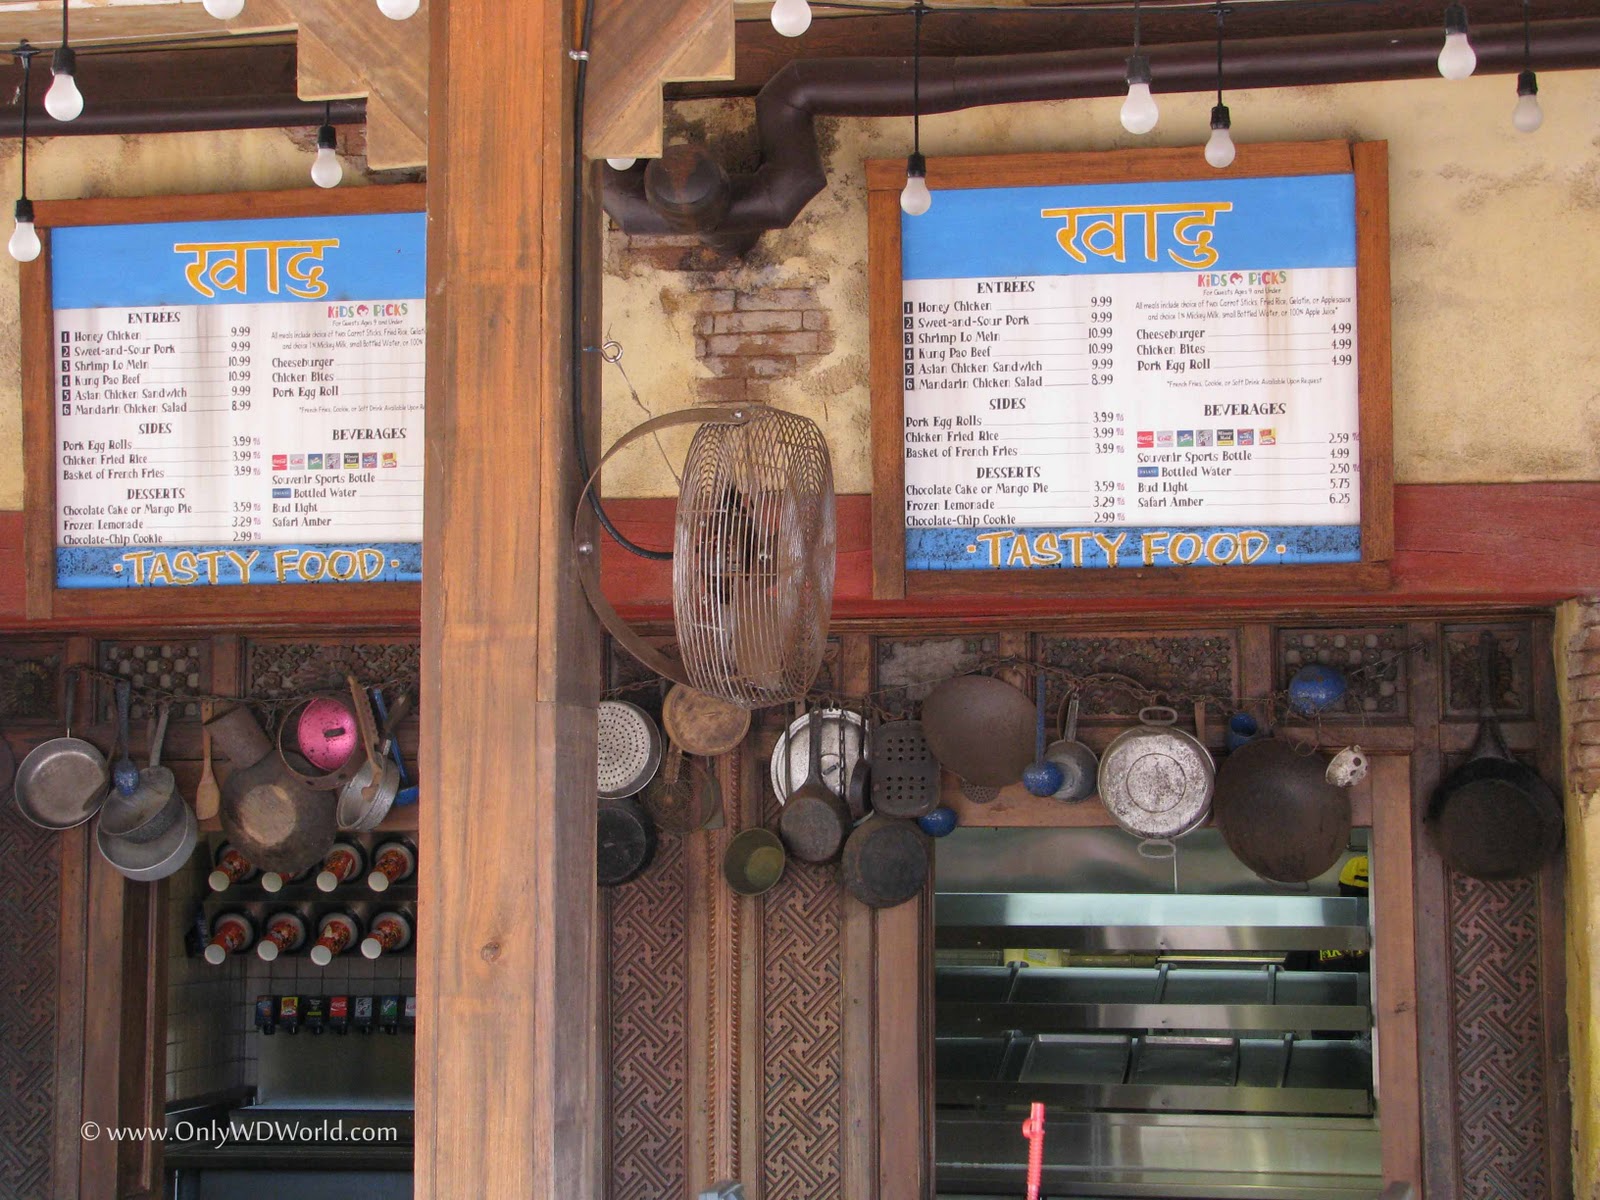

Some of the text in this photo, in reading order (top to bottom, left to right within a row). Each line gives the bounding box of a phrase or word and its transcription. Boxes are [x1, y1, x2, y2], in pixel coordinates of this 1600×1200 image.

[1235, 288, 1247, 296] Ages
[918, 296, 1112, 314] Honey Chicken 9.99
[918, 312, 1112, 328] Sweet-and-Sour Pork 9.99
[74, 327, 250, 343] Honey Chicken 9.99
[918, 327, 1112, 344] Shrimp Lo Mein 10.99
[1137, 323, 1351, 341] Cheeseburger 4.99
[75, 341, 250, 356] Sweet-and-Sour Pork 9.99
[919, 343, 1113, 361] Kung Pao Beef 10.99
[1137, 339, 1351, 356] Chicken Bites 4.99
[75, 356, 250, 372] Shrimp Lo Mein 10.99
[272, 358, 334, 370] Cheeseburger
[918, 358, 1113, 374] Asian Chicken Sandwich 9.99
[1137, 355, 1351, 373] Pork Egg Roll 4.99
[75, 371, 250, 387] Kung Pao Beef 10.99
[272, 372, 334, 383] Chicken Bites
[919, 374, 1113, 389] Mandarin Chicken Salad 8.99
[75, 386, 250, 400] Asian Chicken Sandwich 9.99
[272, 386, 338, 399] Pork Egg Roll
[75, 401, 251, 415] Mandarin Chicken Salad 8.99
[989, 398, 1027, 410] SIDES
[1204, 403, 1286, 417] BEVERAGES
[906, 412, 1113, 429] Pork Egg Rolls 3.99
[139, 423, 172, 434] SIDES
[332, 428, 407, 440] BEVERAGES
[906, 428, 1114, 442] Chicken Fried Rice 3.99
[63, 436, 251, 452] Pork Egg Rolls 3.99
[1329, 433, 1349, 444] 2.59
[63, 451, 251, 465] Chicken Fried Rice 3.99
[906, 443, 1114, 458] Basket of French Fries 3.99
[1138, 449, 1349, 464] Souvenir Sports Bottle 4.99
[63, 466, 251, 480] Basket of French Fries 3.99
[976, 466, 1041, 479] DESSERTS
[1162, 466, 1198, 477] Bottled
[1202, 466, 1232, 476] Water
[1330, 463, 1350, 474] 2.50
[906, 481, 1115, 496] Chocolate Cake or Mango Pie 3.59
[1138, 478, 1350, 494] Bud Light 5.75
[127, 488, 186, 500] DESSERTS
[1138, 494, 1350, 508] Safari Amber 6.25
[63, 502, 251, 516] Chocolate Cake or Mango Pie 3.59
[907, 496, 1115, 511] Frozen Lemonade 3.29
[64, 517, 251, 530] Frozen Lemonade 3.29
[907, 512, 1115, 527] Chocolate-Chip Cookie 2.99
[64, 531, 251, 546] Chocolate-Chip Cookie 2.99
[977, 530, 1269, 568] TASTY FOOD
[123, 549, 384, 585] TASTY FOOD
